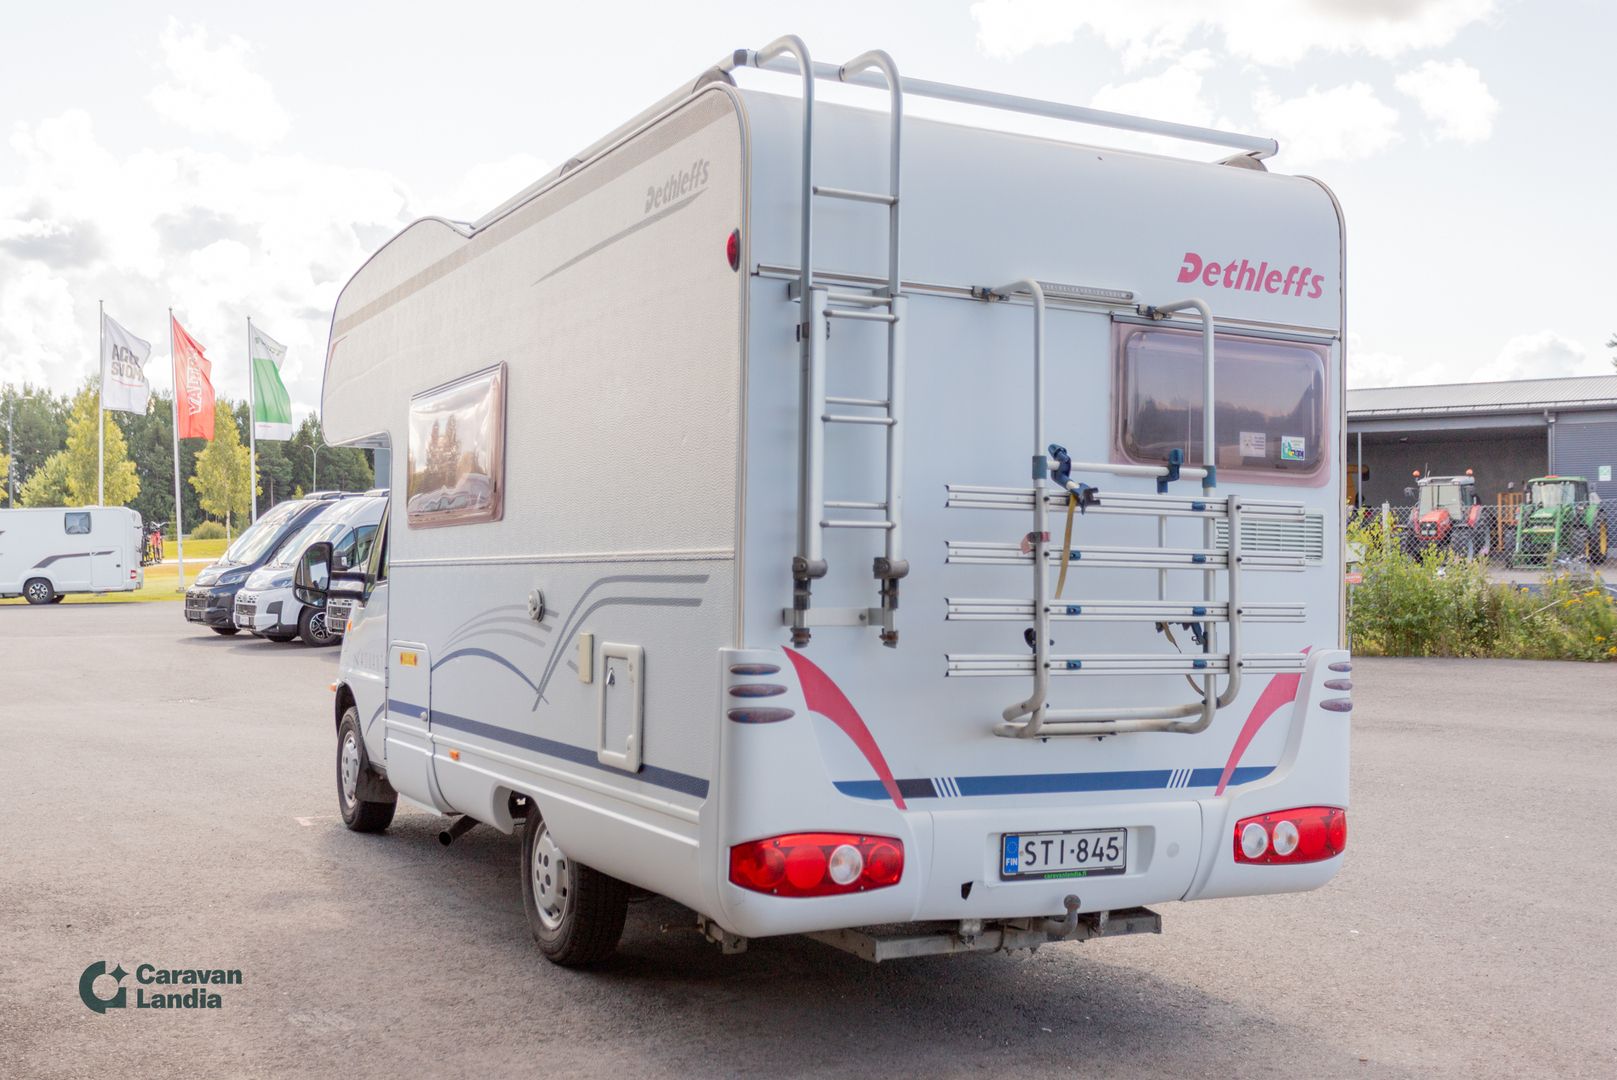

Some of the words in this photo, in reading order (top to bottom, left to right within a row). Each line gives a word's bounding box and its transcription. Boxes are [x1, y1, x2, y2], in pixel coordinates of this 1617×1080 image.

[644, 158, 710, 214] Dethleffs
[1177, 252, 1325, 299] Dethleffs
[1005, 857, 1018, 866] FIN
[1024, 836, 1120, 866] STI-845
